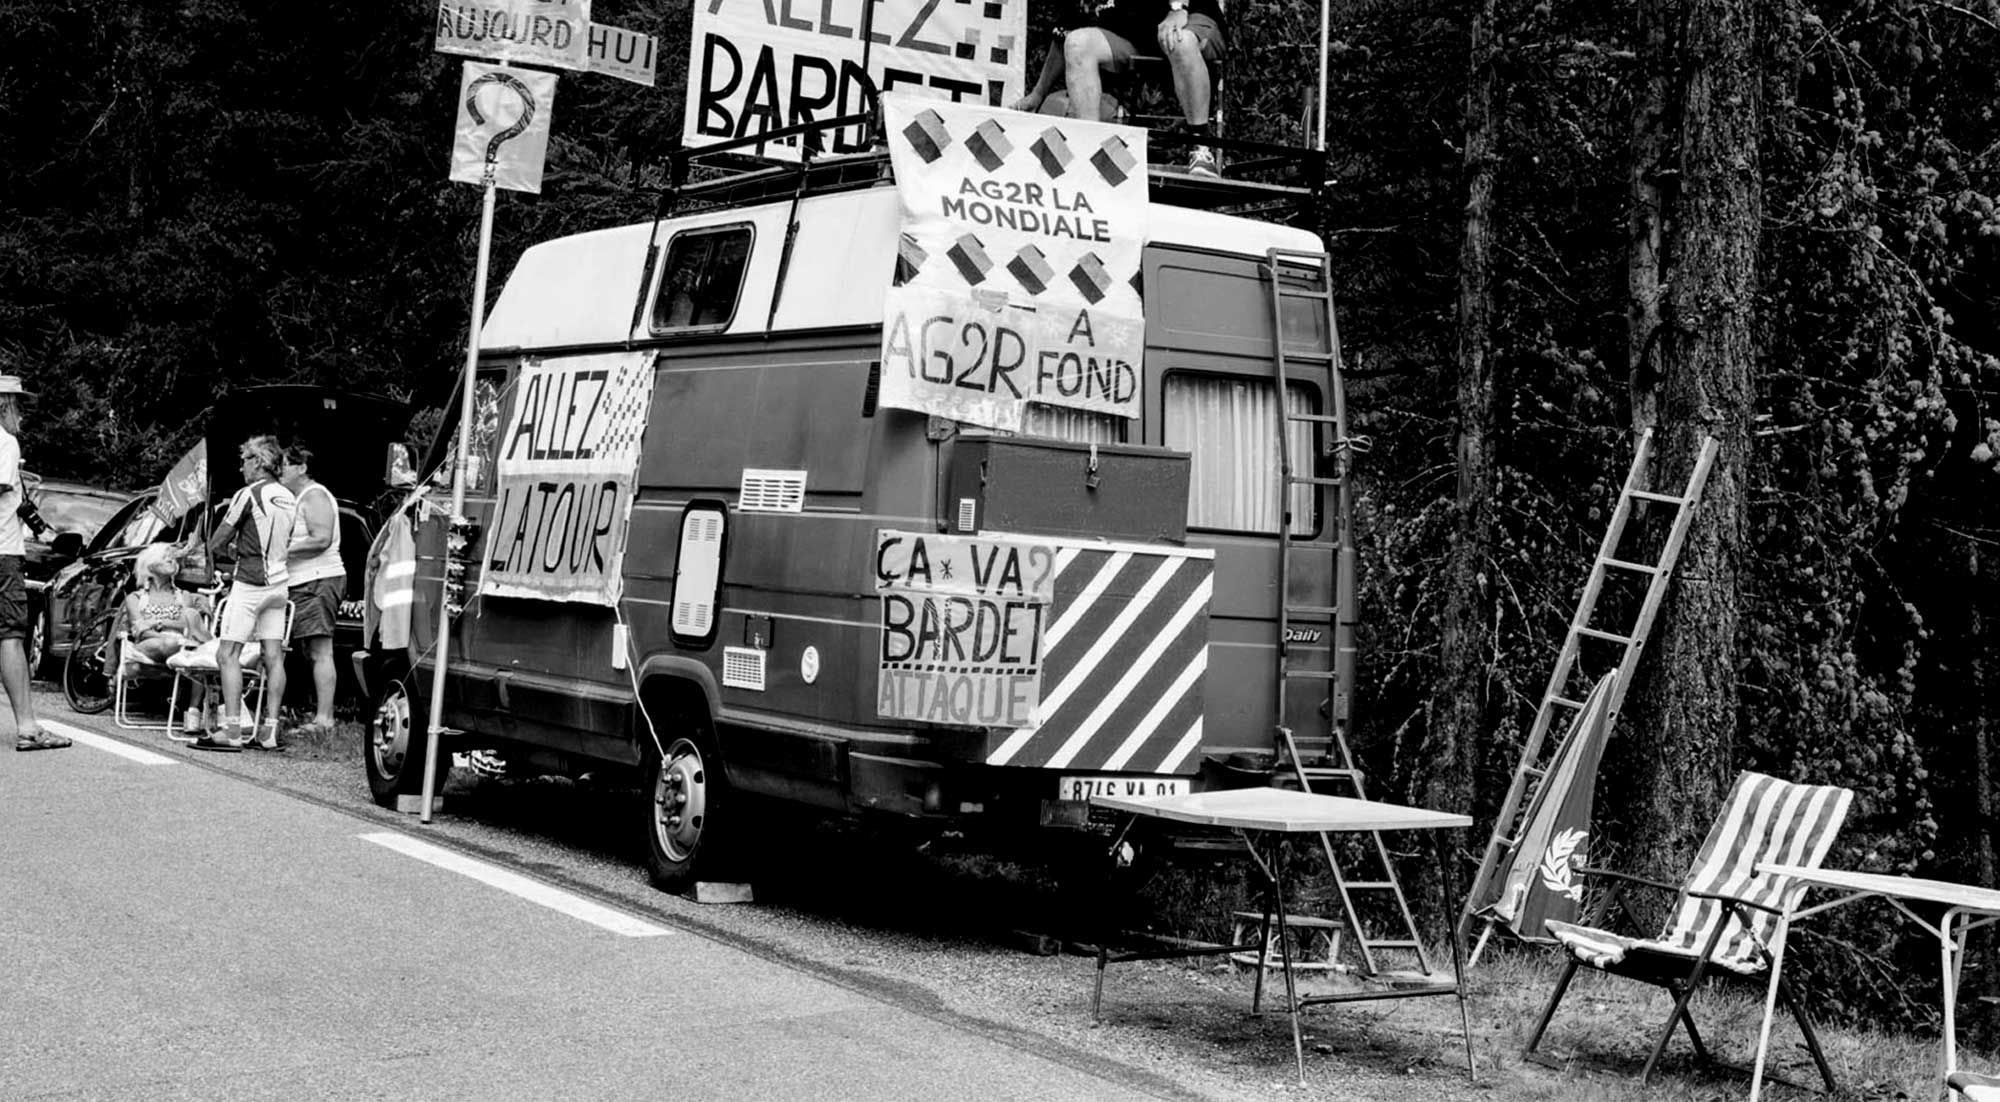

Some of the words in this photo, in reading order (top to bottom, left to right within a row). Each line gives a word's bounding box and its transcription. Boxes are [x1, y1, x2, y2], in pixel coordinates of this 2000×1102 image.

[588, 26, 653, 69] HUI
[941, 195, 1111, 243] MONDIALE
[959, 177, 1044, 207] AG2R
[1052, 188, 1094, 213] LA
[1067, 308, 1095, 347] A
[881, 311, 1026, 400] AG2R
[1036, 350, 1136, 404] FOND
[506, 370, 609, 460] ALLEZ
[489, 481, 618, 575] LATOUR
[877, 536, 932, 589] ÇA
[882, 594, 1043, 665] BARDET
[1285, 628, 1321, 641] Daily
[879, 669, 1034, 725] ATTAQUE
